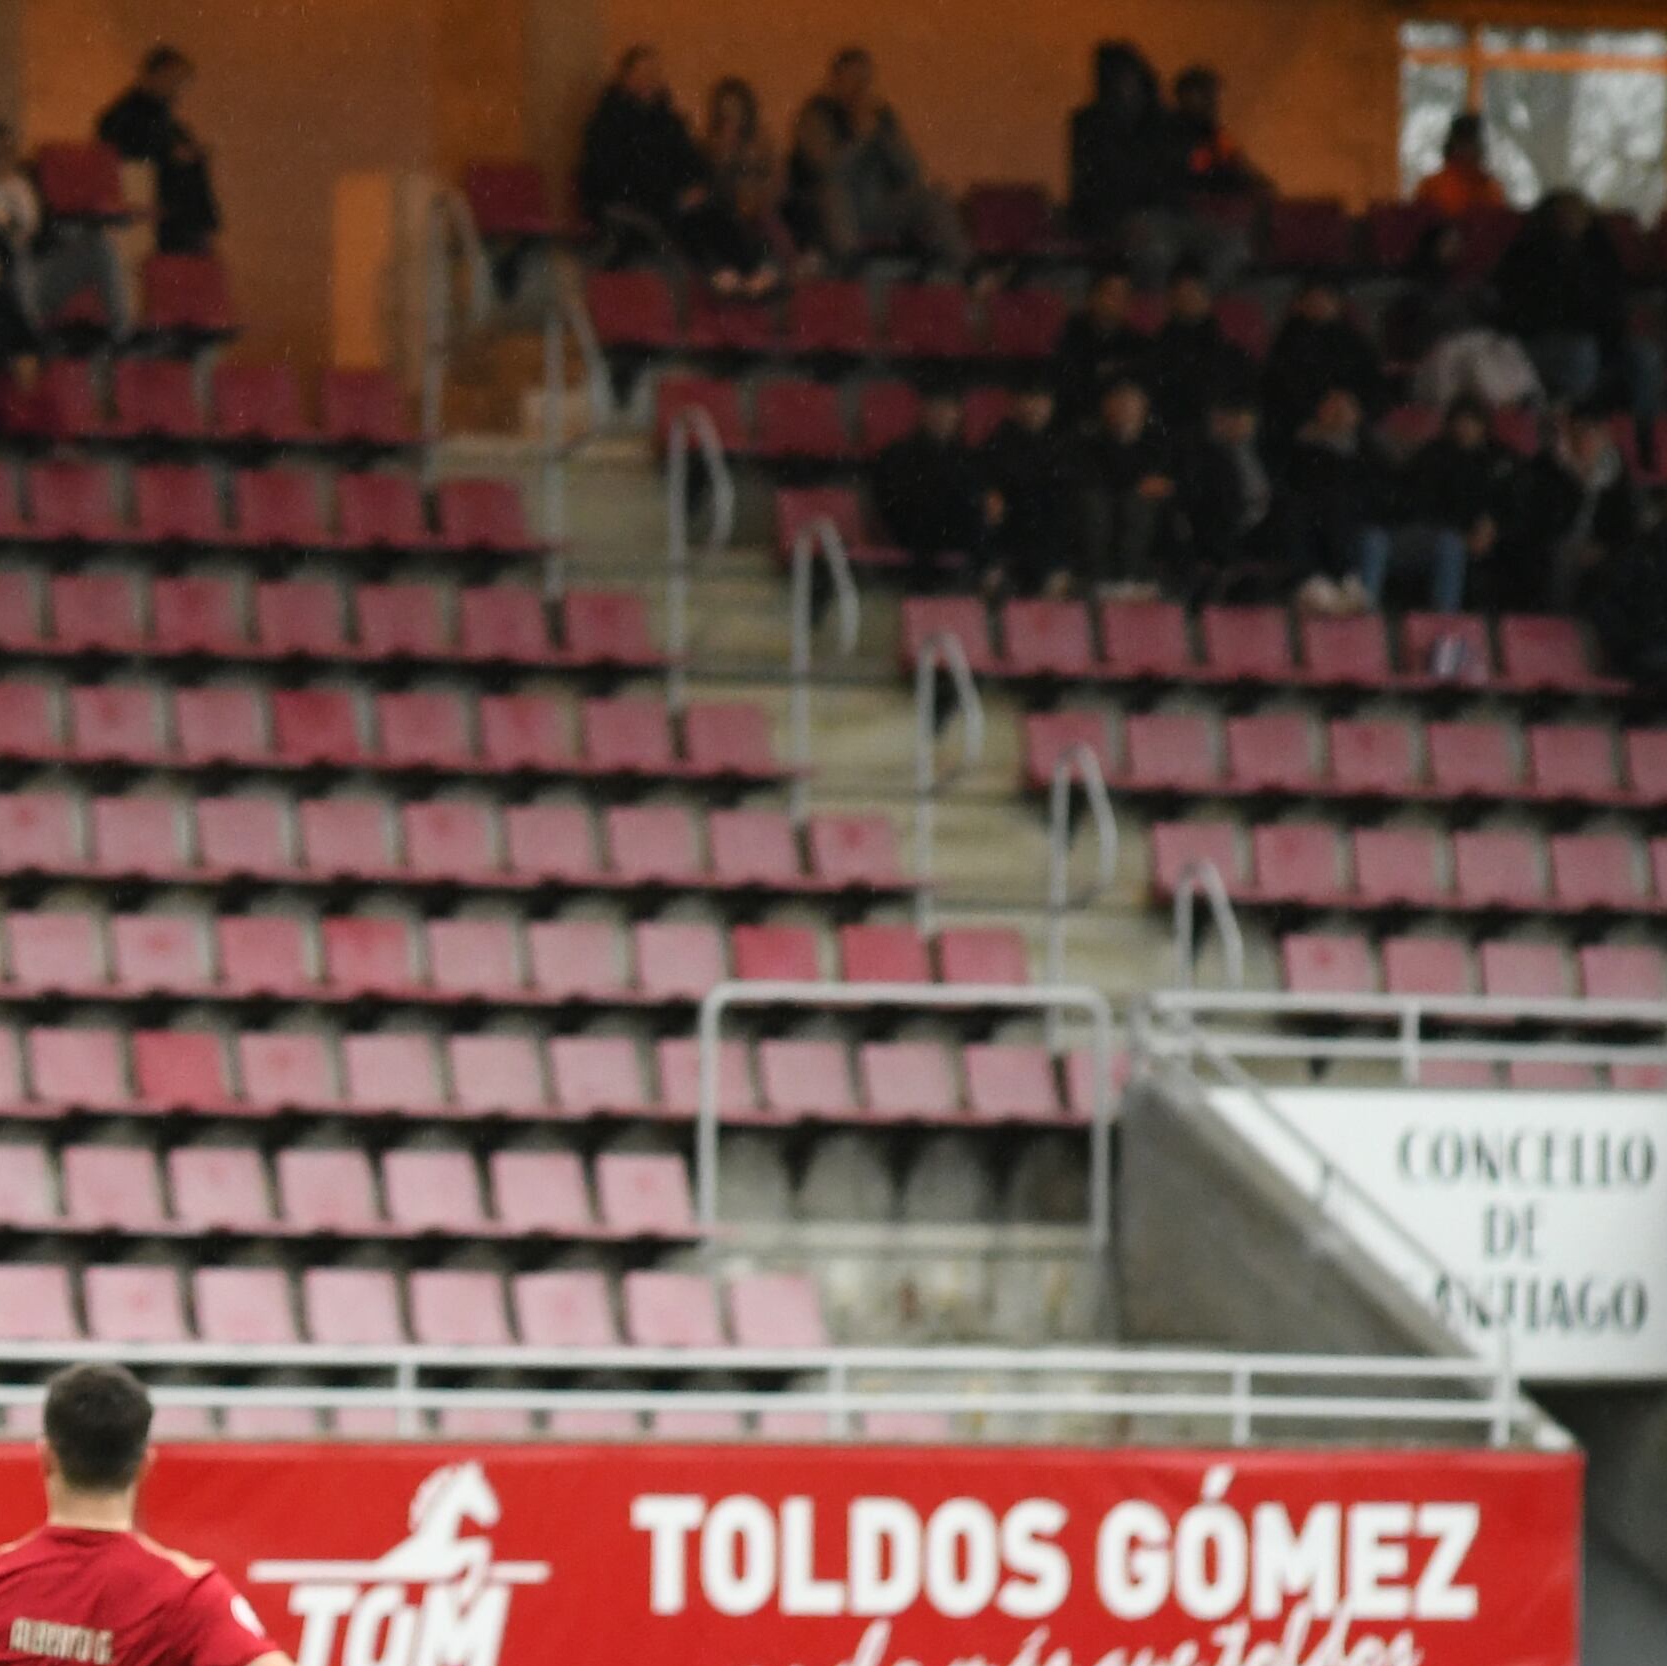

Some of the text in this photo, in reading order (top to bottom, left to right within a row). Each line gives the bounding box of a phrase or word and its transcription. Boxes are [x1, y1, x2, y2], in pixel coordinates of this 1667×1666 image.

[1395, 1128, 1658, 1187] CONCELLO
[1482, 1203, 1537, 1258] DE
[632, 1465, 1481, 1621] TOLDOS GÓMEZ
